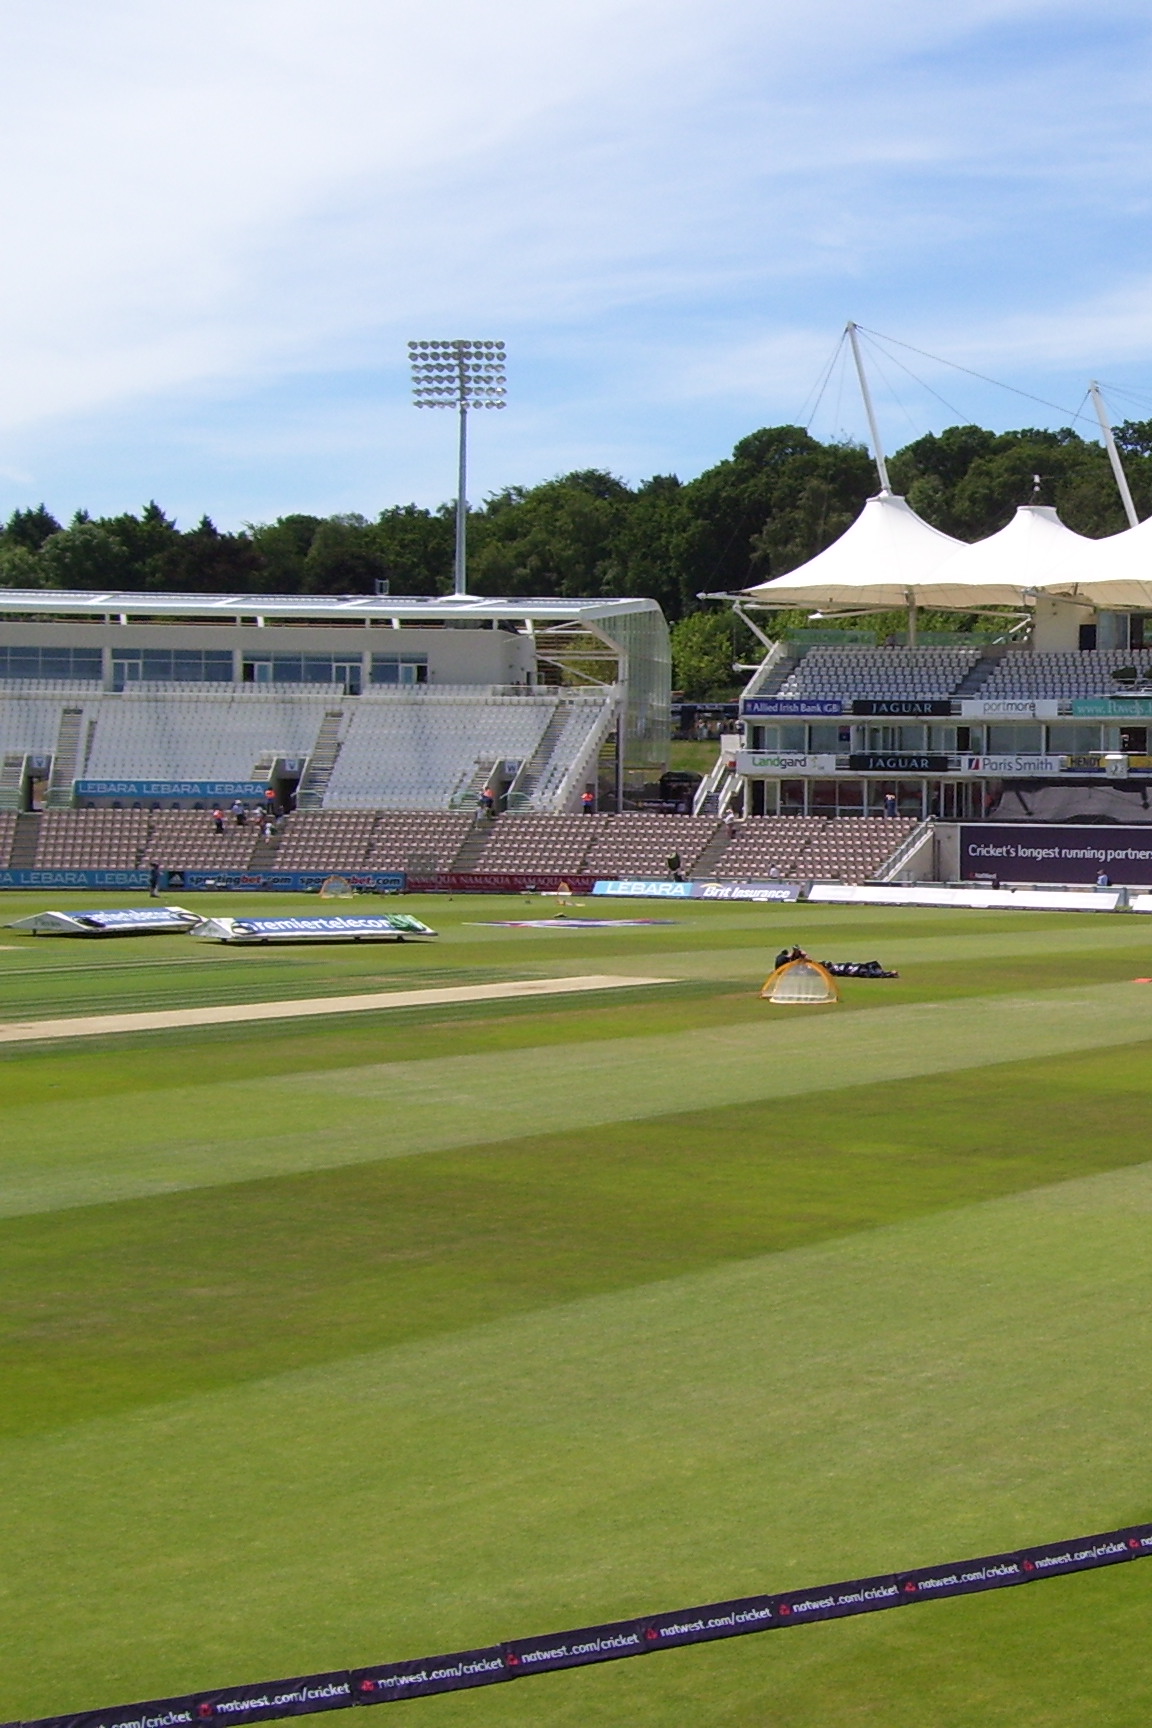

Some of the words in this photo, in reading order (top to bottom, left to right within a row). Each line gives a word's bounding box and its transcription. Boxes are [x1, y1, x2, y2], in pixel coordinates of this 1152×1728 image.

[801, 702, 822, 713] Bank
[872, 703, 932, 714] JAGUAR
[983, 700, 1037, 714] portmore
[752, 756, 807, 769] Landgard
[868, 757, 929, 768] JAGUAR
[982, 757, 1013, 771] Paris
[1015, 756, 1053, 771] Smith
[79, 782, 137, 793] LEBARA
[143, 782, 200, 794] LEBARA
[206, 783, 264, 794] LEBARA
[968, 844, 1016, 857] Cricket's
[1017, 844, 1060, 862] longest
[1061, 846, 1106, 862] running
[20, 872, 88, 884] LEBARA
[95, 872, 151, 884] LEBAR
[606, 881, 686, 895] LEBARA
[703, 884, 733, 898] Brit
[733, 885, 791, 899] Insurance
[1034, 1540, 1128, 1570] natwest.com/cricket
[917, 1563, 1020, 1591] natwest.com/cricket
[792, 1583, 900, 1614] natwest.com/cricket
[659, 1606, 772, 1638] natwest.com/cricket
[521, 1633, 640, 1664] natwest.com/cricket
[377, 1657, 504, 1690] natwest.com/cricket
[216, 1682, 350, 1714] natwest.com/cricket
